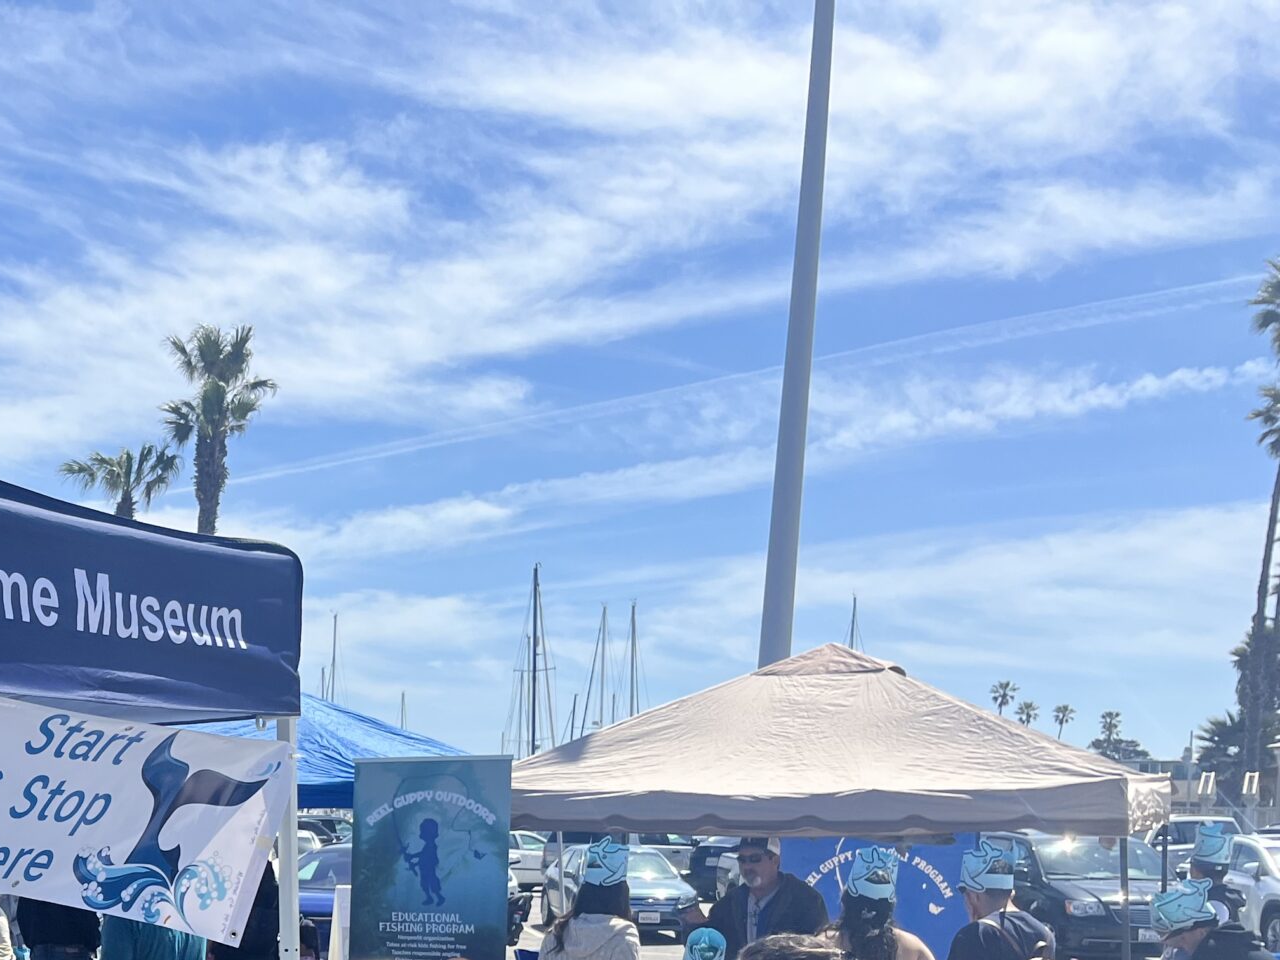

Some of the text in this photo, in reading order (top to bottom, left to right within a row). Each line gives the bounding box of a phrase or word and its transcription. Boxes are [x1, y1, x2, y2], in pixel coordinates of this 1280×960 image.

[73, 567, 248, 651] Museum
[25, 713, 146, 766] Start
[9, 774, 113, 837] Stop
[366, 790, 496, 827] REEL GUPPY OUTDOORS
[819, 850, 854, 874] GUPPY
[912, 857, 954, 898] PROGRAM
[379, 922, 475, 935] FISHING PROGRAM
[391, 911, 462, 924] EDUCATIONAL
